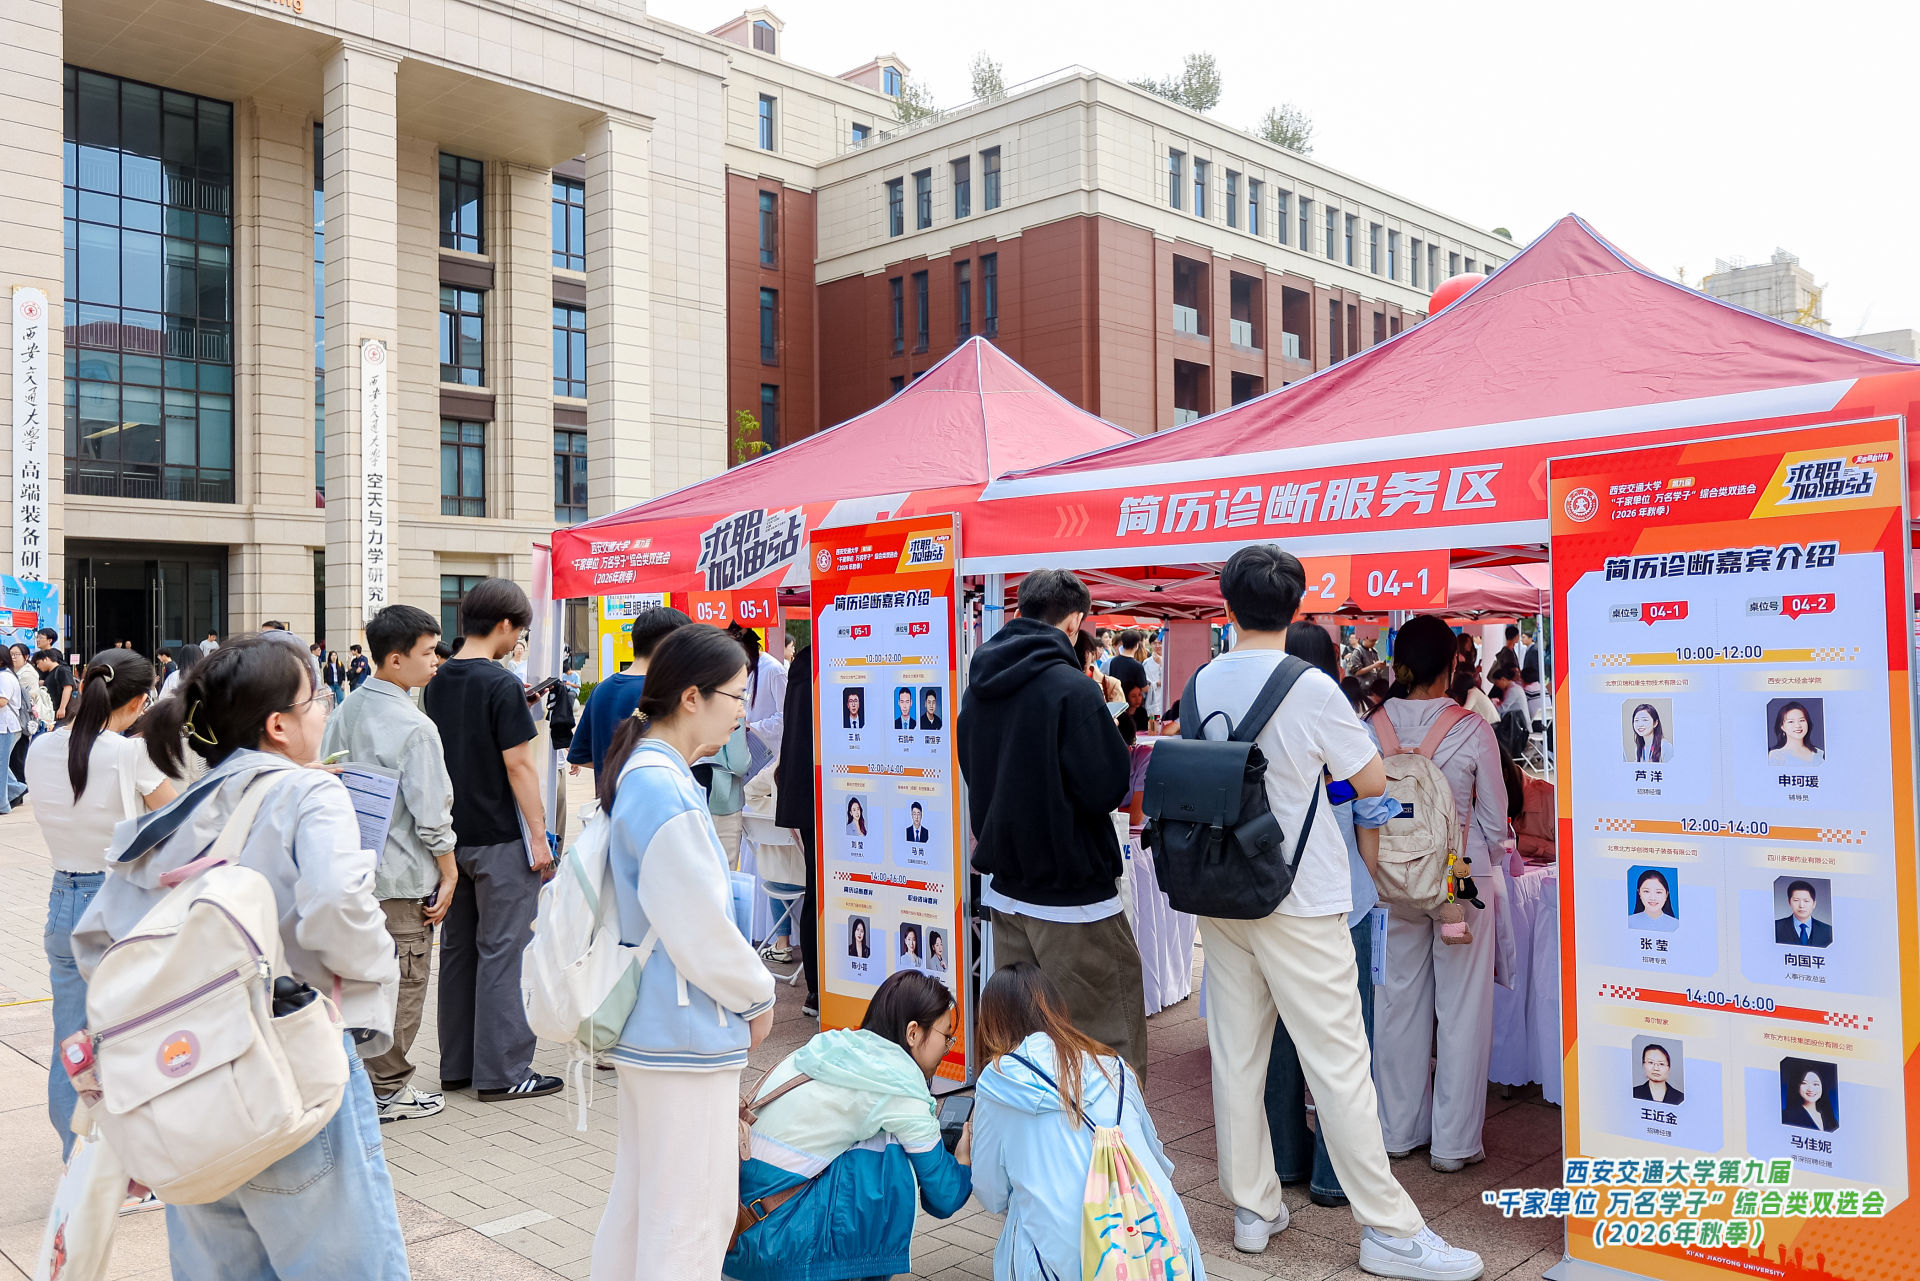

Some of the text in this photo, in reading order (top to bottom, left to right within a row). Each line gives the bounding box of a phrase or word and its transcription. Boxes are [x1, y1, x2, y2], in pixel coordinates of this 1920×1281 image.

[1609, 480, 1662, 496] 西安交通大学
[1700, 483, 1757, 500] 综合类双选会
[1115, 462, 1503, 537] 简历诊断服务区
[1604, 542, 1838, 582] 简历诊断嘉宾介绍
[1366, 568, 1430, 599] 04-1
[739, 599, 770, 619] 05-1
[835, 590, 930, 612] 简历诊断嘉宾介绍
[1749, 598, 1827, 613] 桌位号 04-2
[697, 602, 727, 621] 05-2
[1612, 605, 1680, 619] 桌位号 04-1
[854, 627, 868, 635] 05-1
[912, 624, 927, 632] 05-2
[865, 653, 902, 663] 10:00-12:00
[1675, 644, 1762, 661] 10:00-12:00
[1681, 818, 1770, 836] 12:00-14:00
[870, 871, 907, 885] 14:00-16:00
[1642, 956, 1667, 965] 招聘专员
[1784, 953, 1826, 969] 向国平
[1785, 972, 1826, 984] 人事行政总监
[1685, 988, 1775, 1012] 14:00-16:00
[1763, 1032, 1854, 1052] 京东方科技集团股份有限公司
[1640, 1108, 1678, 1125] 王近金
[1646, 1127, 1672, 1138] 招聘经理
[1790, 1134, 1832, 1155] 马佳妮
[1686, 1249, 1786, 1278] XI'AN JIAOTONG UNIVERSITY
